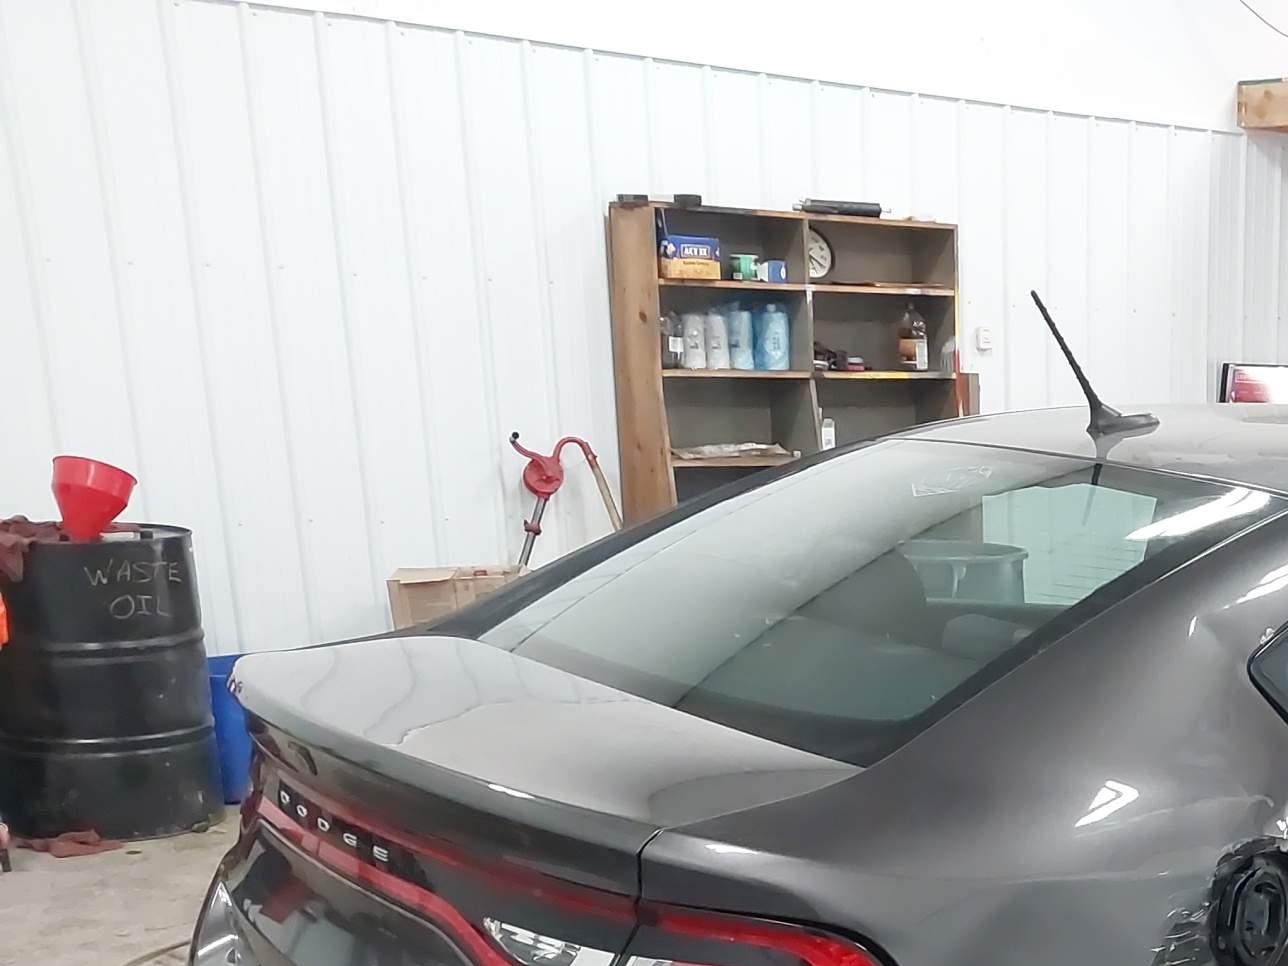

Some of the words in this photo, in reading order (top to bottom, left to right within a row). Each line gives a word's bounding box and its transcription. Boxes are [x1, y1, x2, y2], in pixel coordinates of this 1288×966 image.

[84, 558, 183, 587] WASTE
[108, 594, 171, 620] OIL
[279, 790, 389, 863] DODGE
